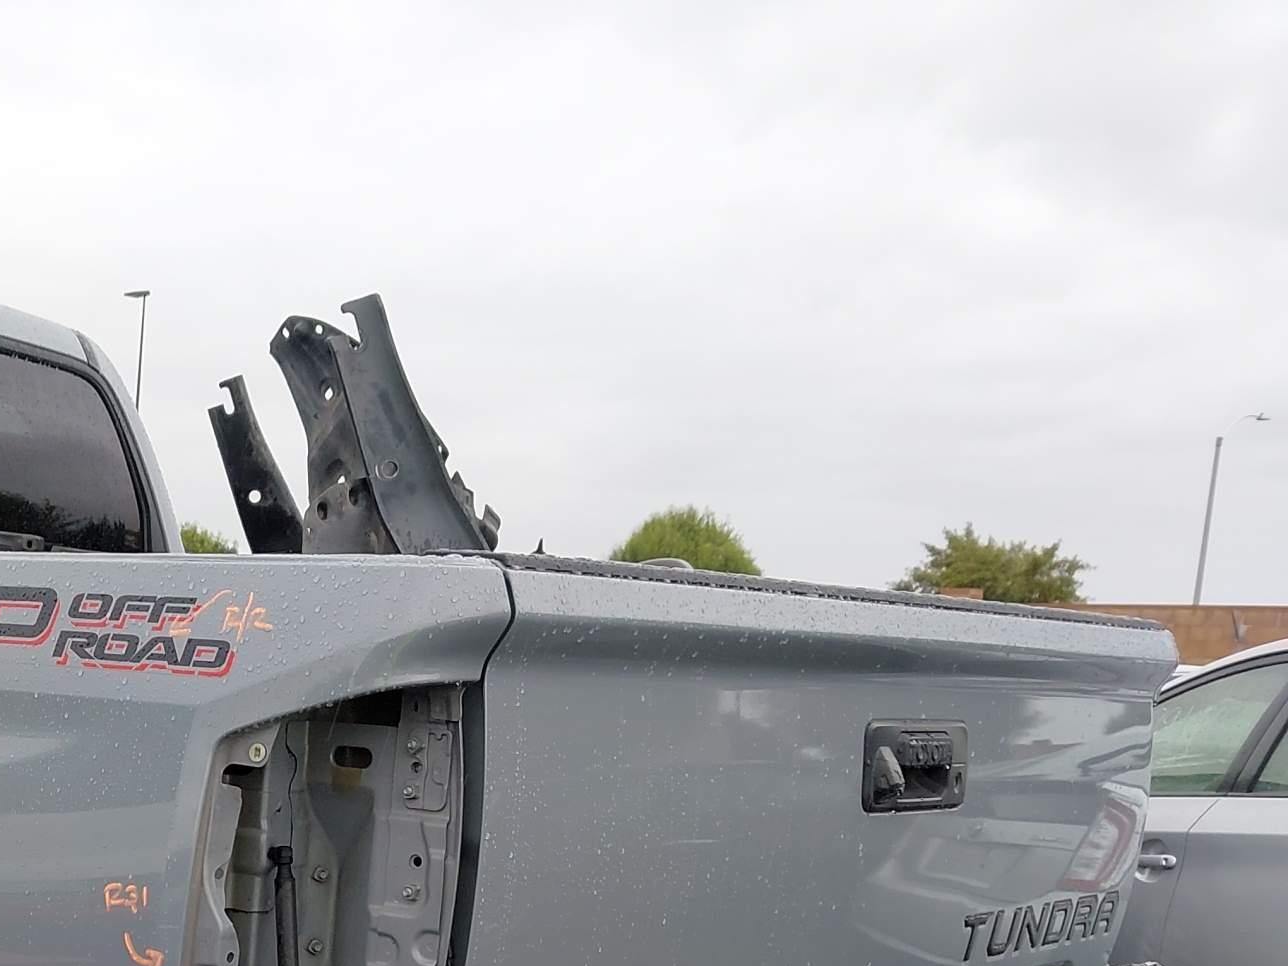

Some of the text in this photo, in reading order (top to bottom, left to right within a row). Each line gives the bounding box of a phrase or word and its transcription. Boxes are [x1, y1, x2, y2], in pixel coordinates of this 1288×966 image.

[67, 592, 199, 632] OFF
[52, 630, 236, 678] ROAD
[963, 890, 1120, 962] TUNDRA
